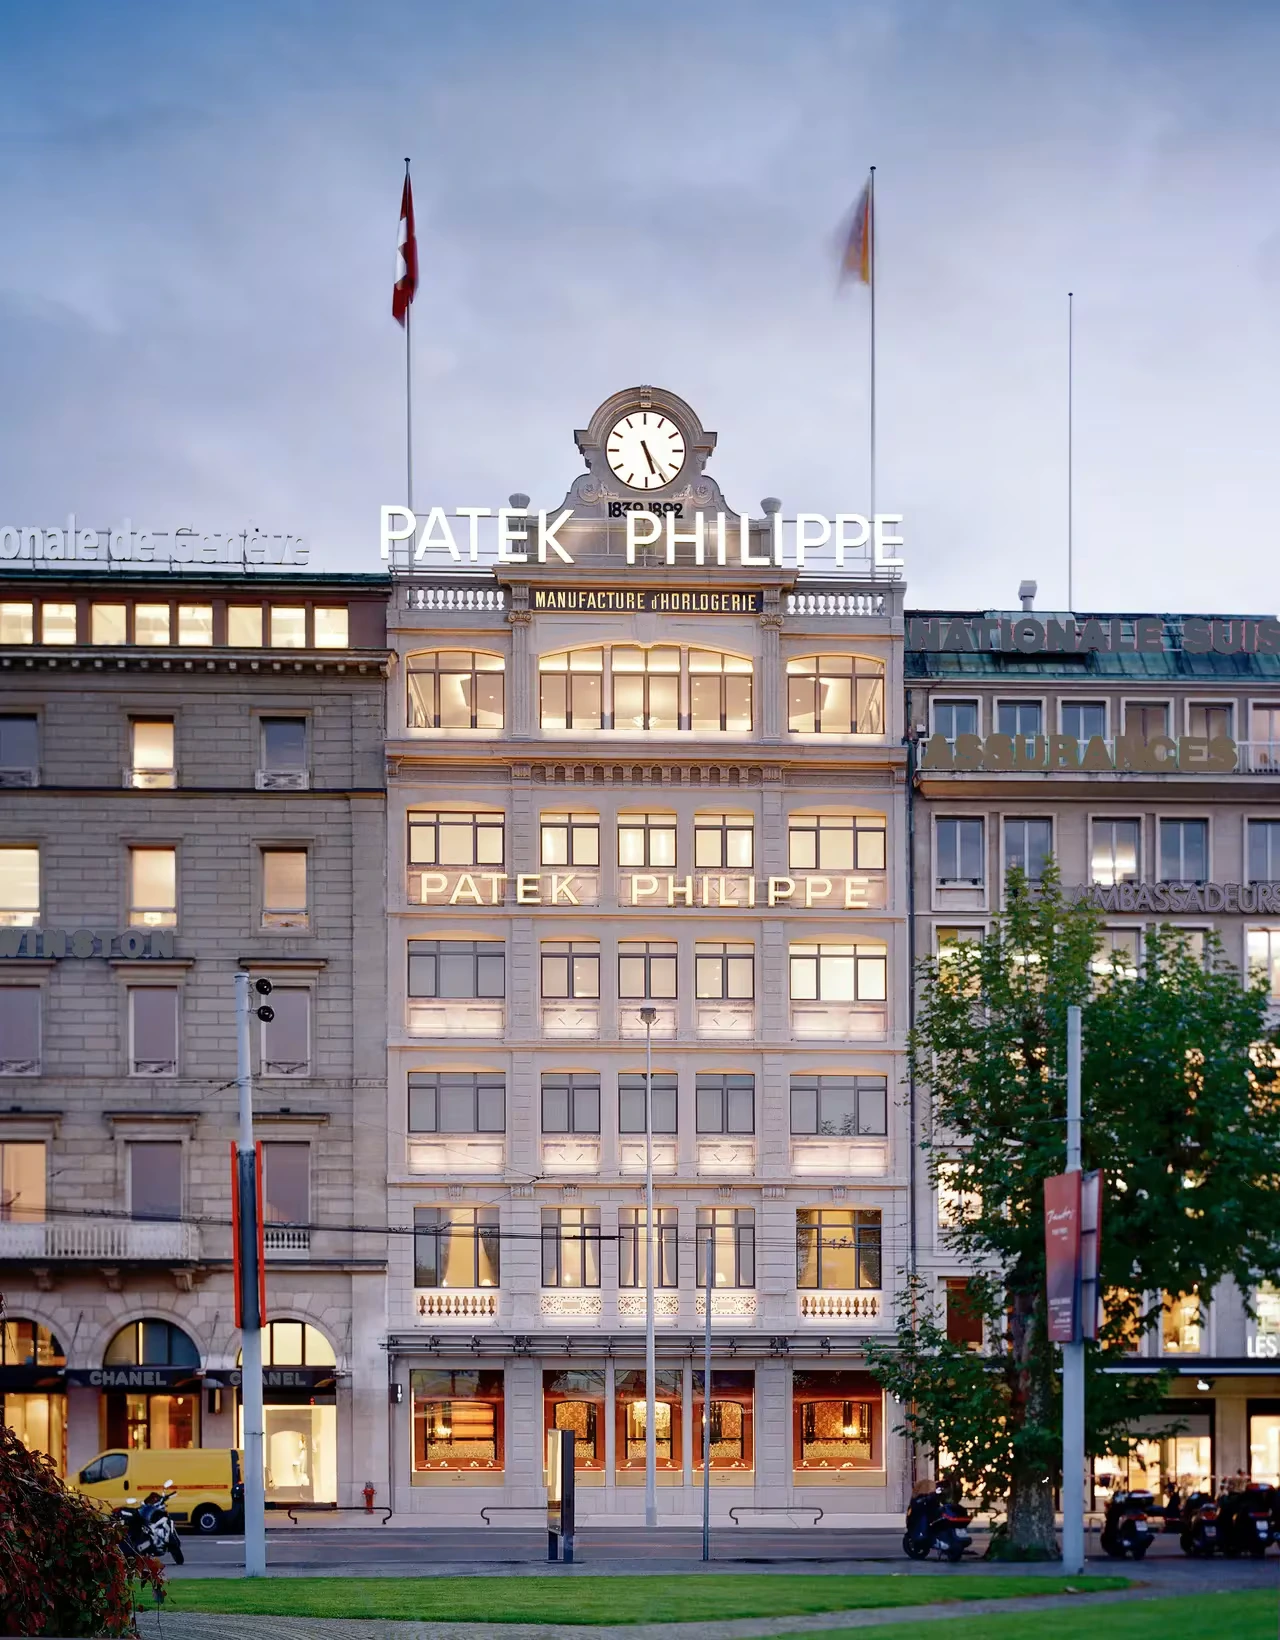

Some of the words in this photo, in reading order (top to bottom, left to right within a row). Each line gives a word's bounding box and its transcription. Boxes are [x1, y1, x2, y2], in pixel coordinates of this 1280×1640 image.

[0, 513, 99, 560] onale
[110, 517, 155, 561] de
[380, 505, 575, 564] PATEK
[626, 511, 904, 568] PHILIPPE
[535, 591, 645, 609] MANUFACTURE
[910, 618, 1165, 653] NATIONALE
[921, 733, 1238, 772] ASSURANCES
[420, 872, 580, 905] PATEK
[630, 874, 870, 909] PHILIPPE
[0, 929, 174, 958] WINSTON
[1247, 1335, 1277, 1358] LES
[89, 1371, 167, 1386] CHANEL
[229, 1371, 306, 1386] CNEL
